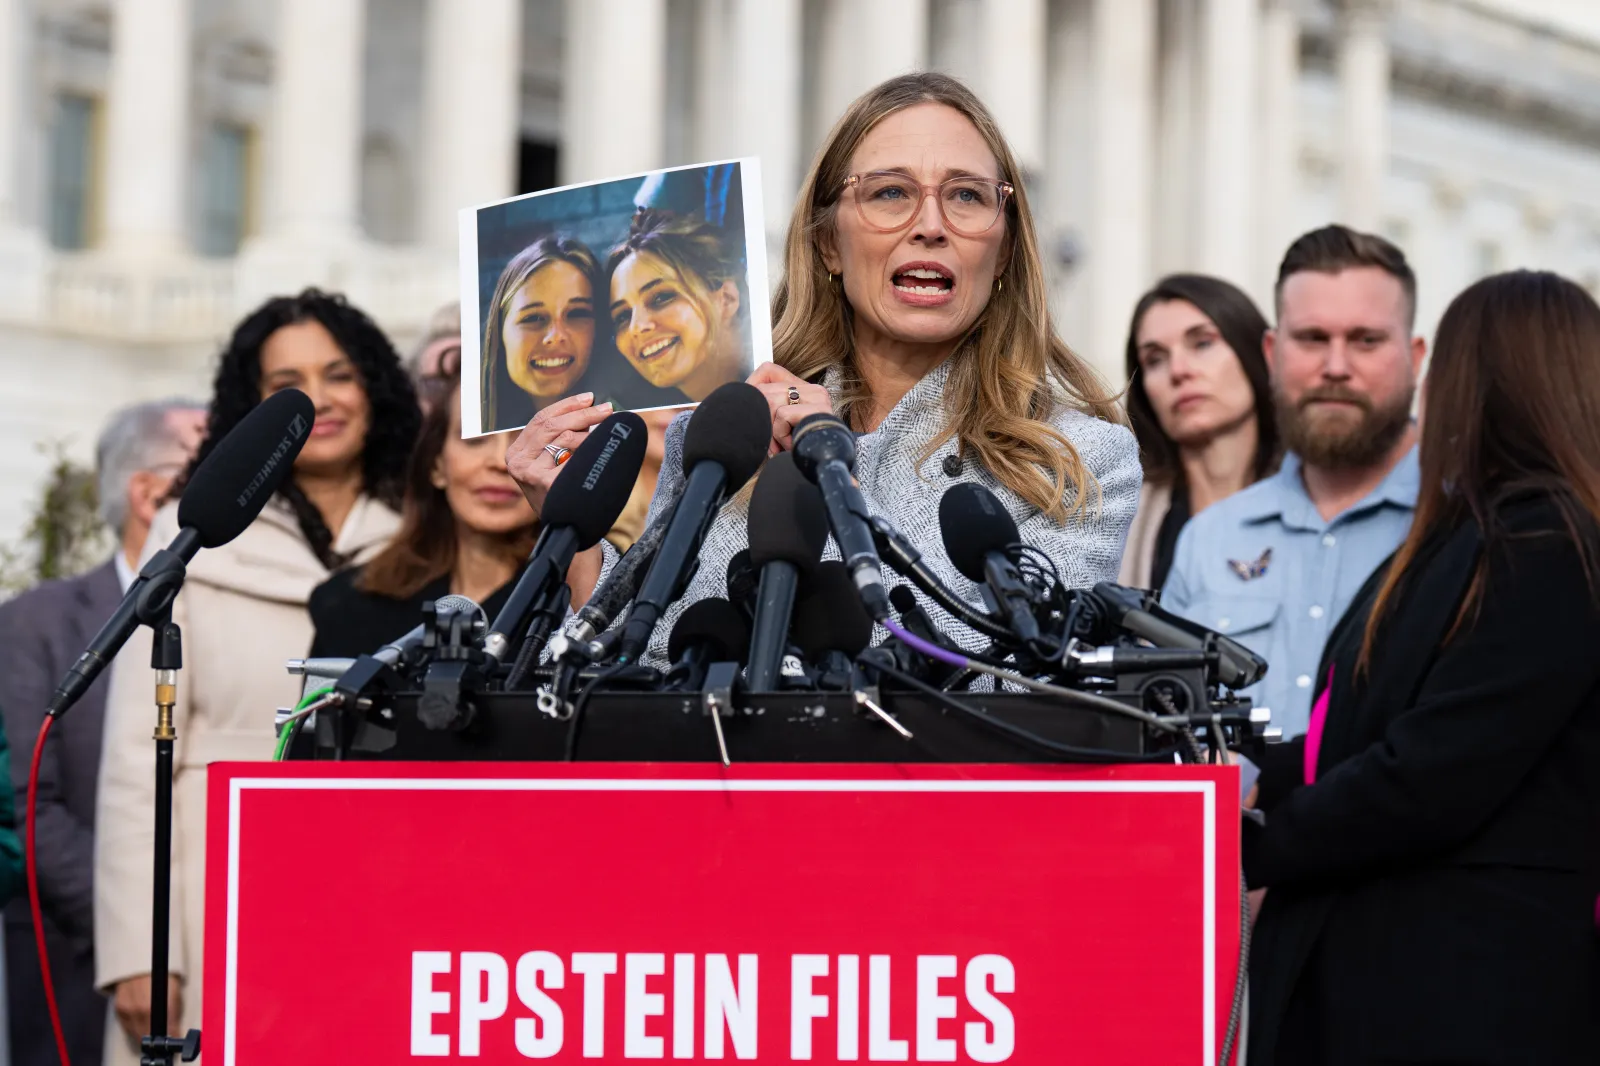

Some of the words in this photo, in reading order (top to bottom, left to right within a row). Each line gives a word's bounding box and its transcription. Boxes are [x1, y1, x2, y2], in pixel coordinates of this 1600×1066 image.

[236, 436, 293, 508] SENNHEISER
[581, 437, 621, 491] SENNHEISER
[410, 951, 758, 1060] EPSTEIN
[790, 954, 1016, 1062] FILES
